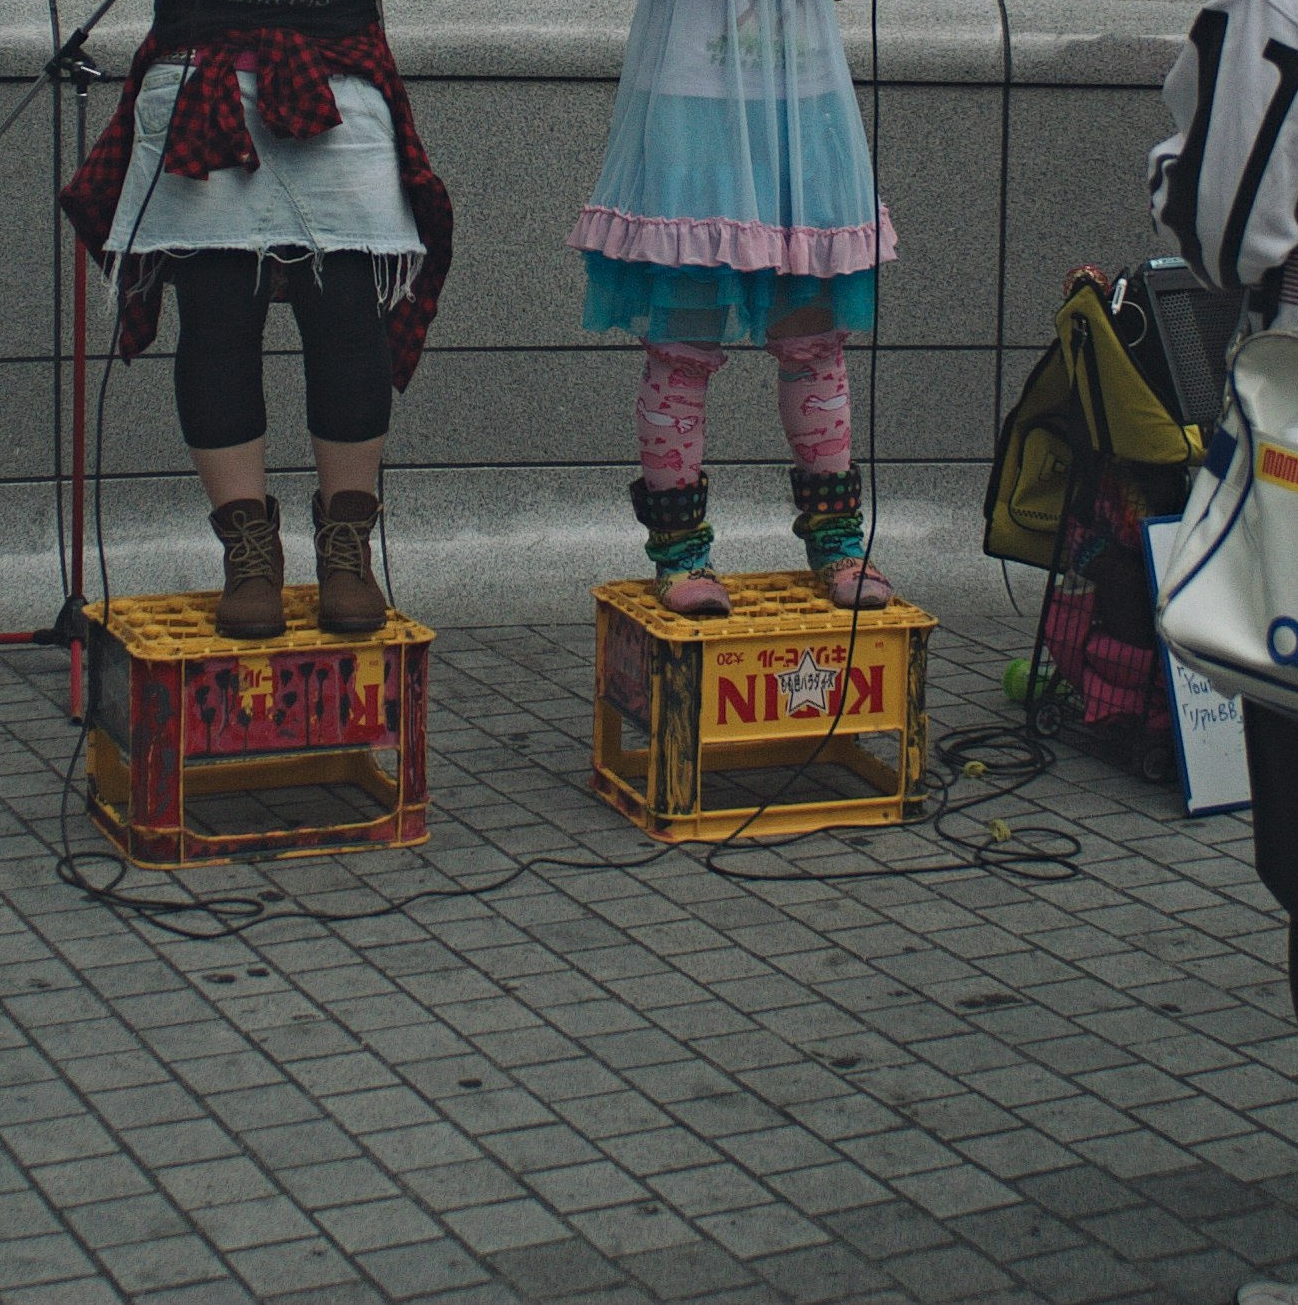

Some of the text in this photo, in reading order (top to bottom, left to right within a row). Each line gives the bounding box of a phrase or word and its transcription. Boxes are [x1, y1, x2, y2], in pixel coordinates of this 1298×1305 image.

[757, 645, 847, 668] キリビール
